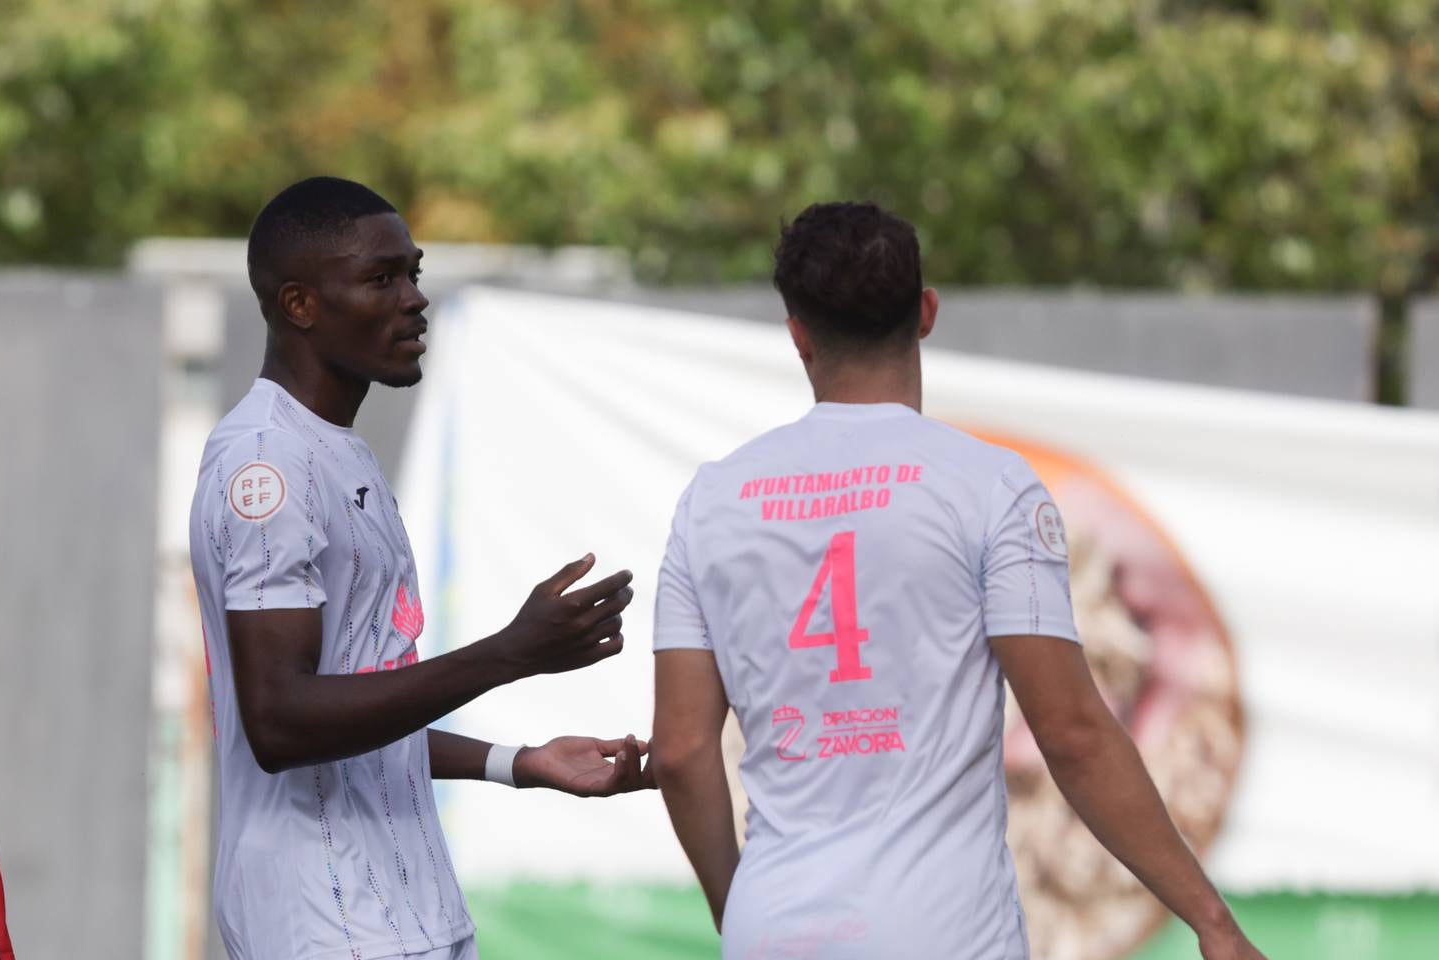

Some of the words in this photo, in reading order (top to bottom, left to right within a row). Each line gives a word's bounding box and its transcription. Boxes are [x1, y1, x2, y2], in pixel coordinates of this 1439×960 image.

[739, 465, 891, 499] AYUNTAMIENTO
[896, 464, 923, 483] DE
[762, 487, 891, 520] VILLARALBO
[788, 530, 873, 683] 4
[816, 731, 906, 759] ZAMORA
